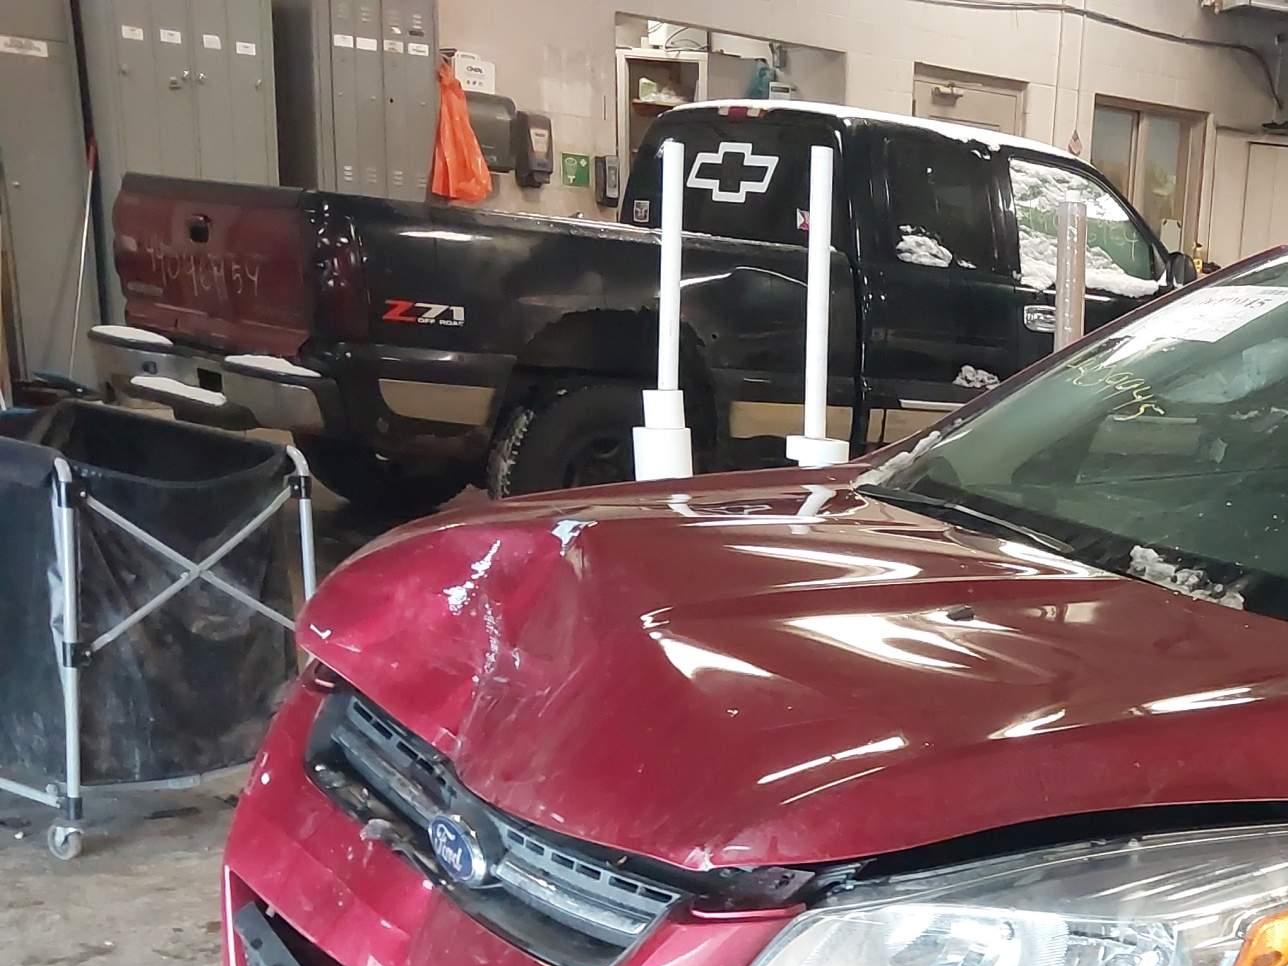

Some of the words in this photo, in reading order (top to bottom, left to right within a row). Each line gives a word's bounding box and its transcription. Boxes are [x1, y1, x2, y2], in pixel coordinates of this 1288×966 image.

[383, 299, 465, 322] Z71
[417, 317, 436, 325] OFF
[435, 823, 463, 871] Ford
